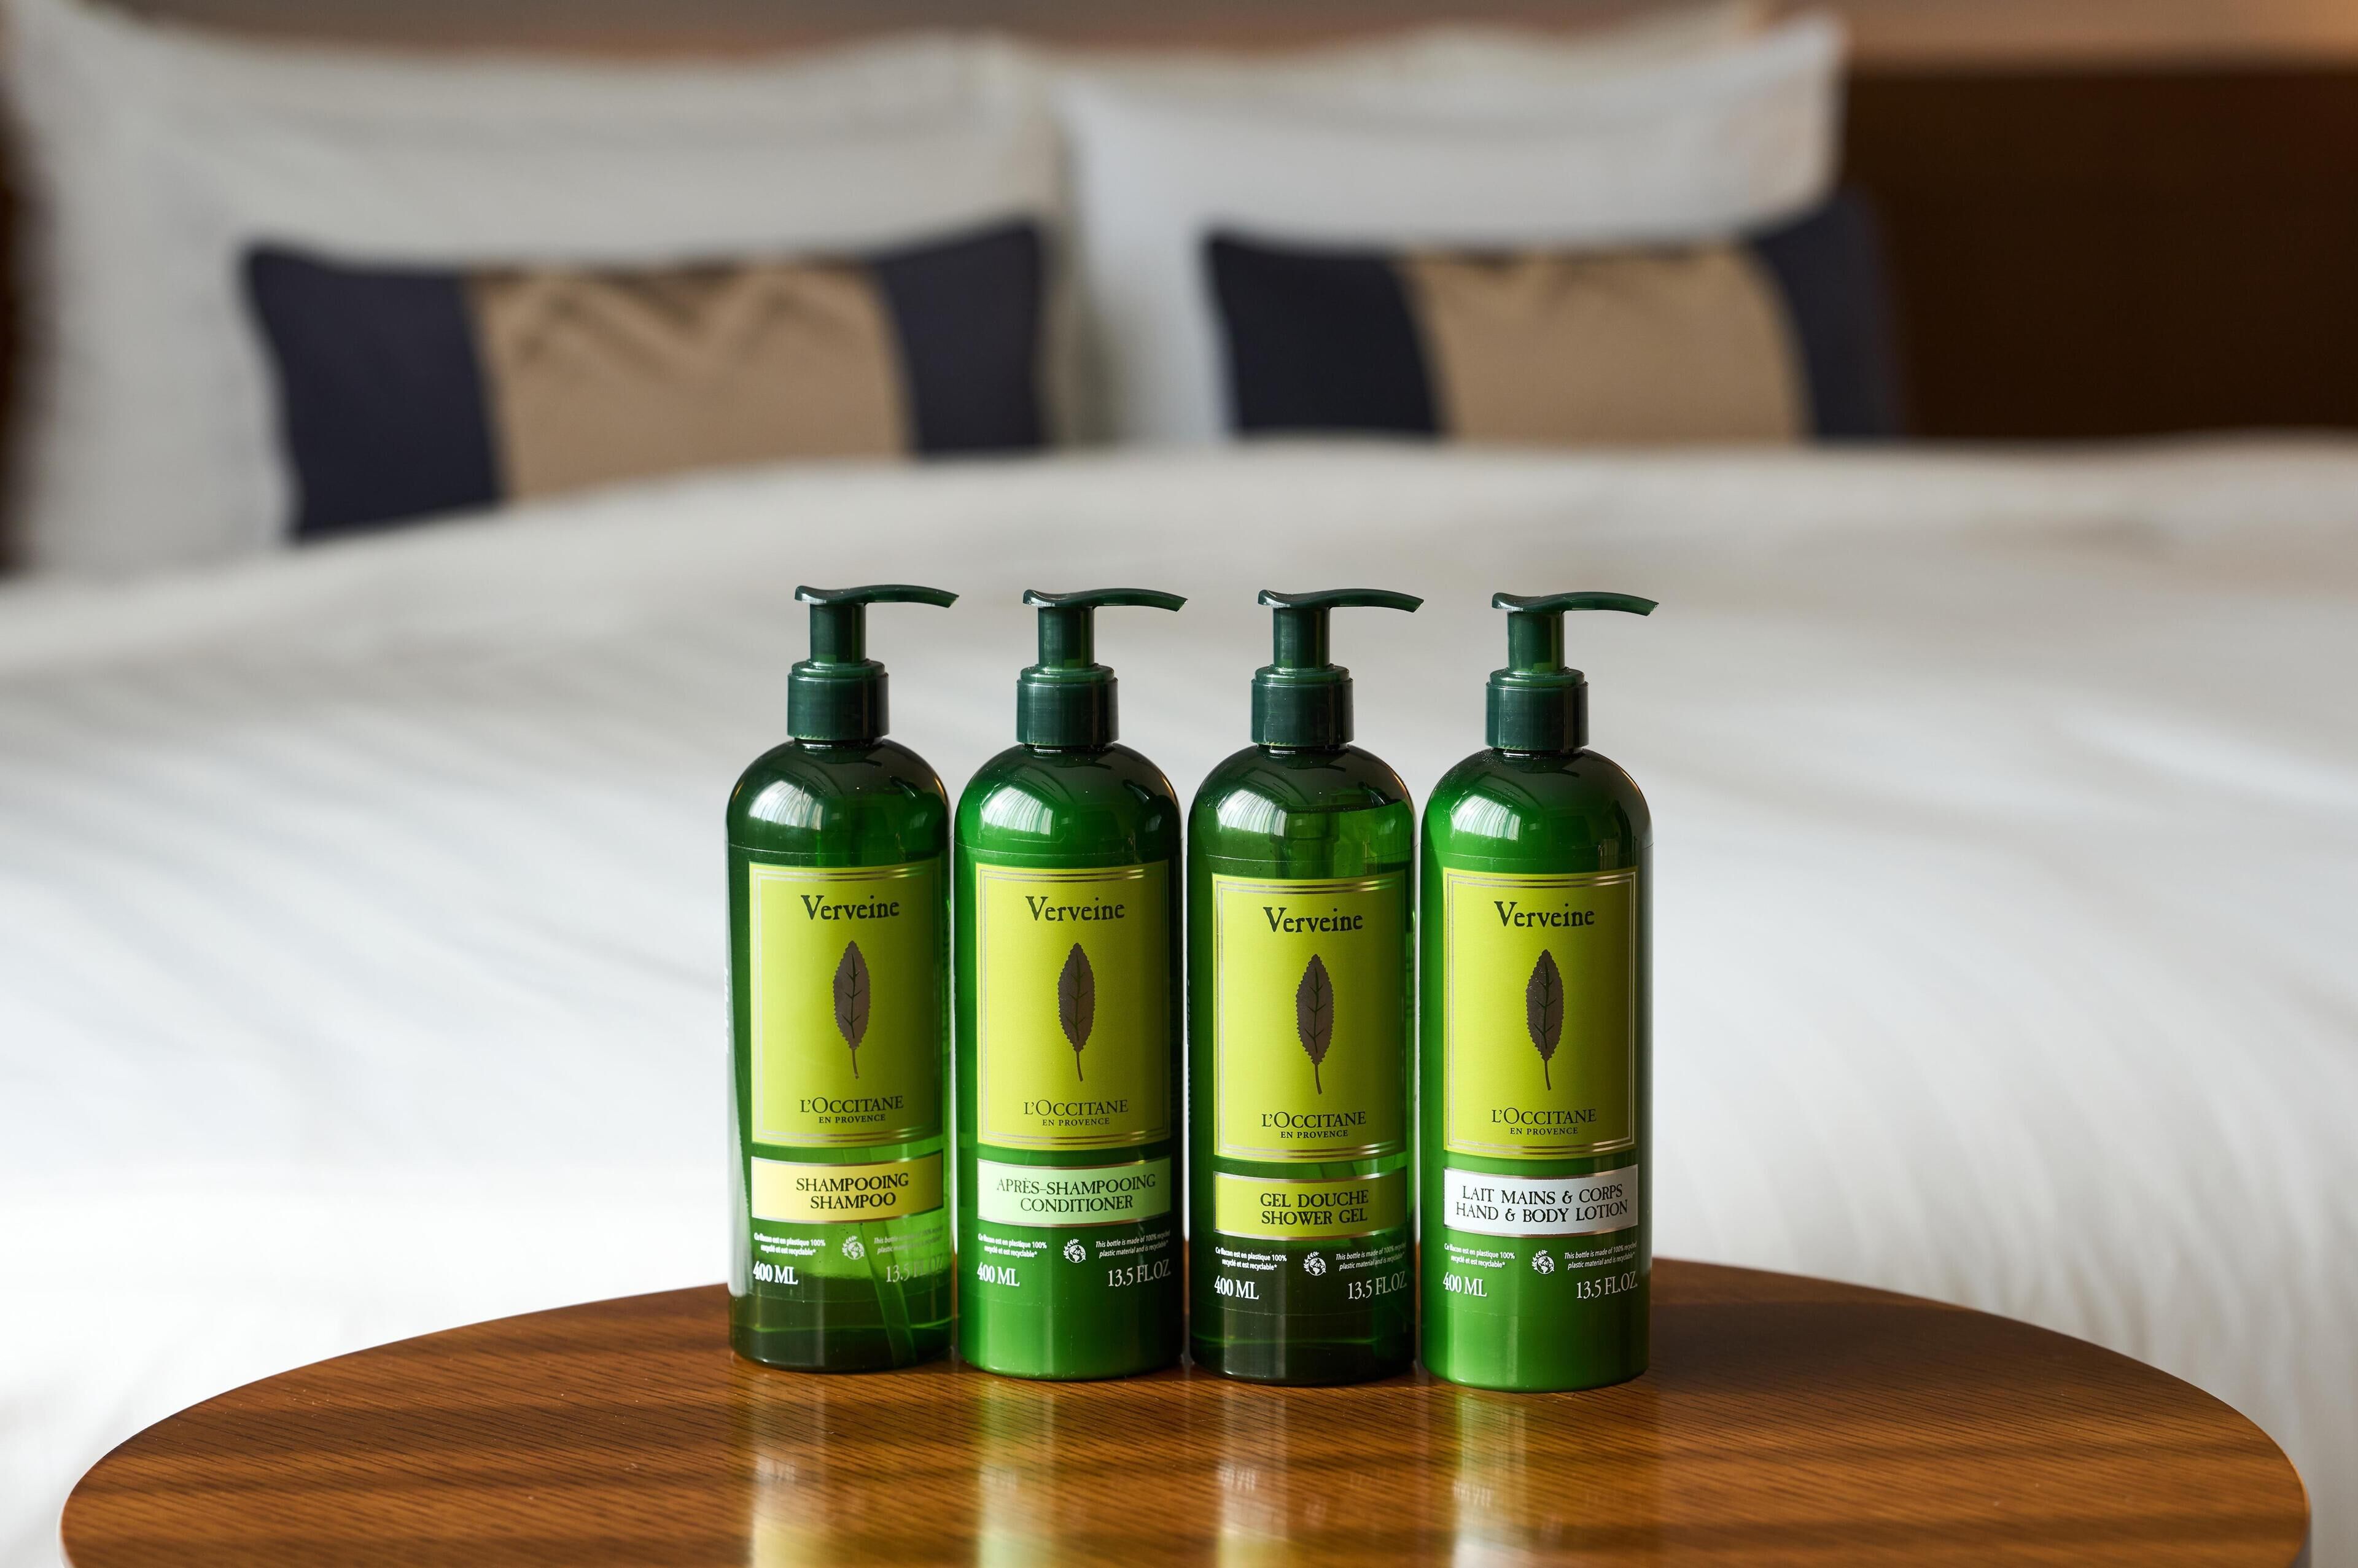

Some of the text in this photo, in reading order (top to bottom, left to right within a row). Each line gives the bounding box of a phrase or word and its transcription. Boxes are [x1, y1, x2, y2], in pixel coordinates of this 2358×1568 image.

[801, 895, 900, 920] Verveine
[1025, 896, 1125, 921] Verveine
[1493, 901, 1595, 927] Verveine
[1263, 906, 1363, 933] Verveine
[835, 1114, 885, 1123] PROVENCE
[1059, 1117, 1110, 1126] PROVENCE
[1297, 1130, 1348, 1138] PROVENCE
[796, 1173, 909, 1192] SHAMPOOING
[811, 1192, 896, 1209] SHAMPOO
[1260, 1190, 1369, 1208] GEL DOUCHE
[1463, 1184, 1622, 1205] LAIT MAINS & CORPS
[1021, 1195, 1133, 1213] CONDITIONER
[1456, 1199, 1627, 1223] HAND & BODY LOTION
[1261, 1208, 1368, 1225] SHOWER GEL
[786, 1238, 809, 1248] plastique
[877, 1246, 893, 1255] plastic
[1008, 1239, 1030, 1249] plastique
[1099, 1250, 1115, 1259] plastic
[1116, 1246, 1136, 1256] material
[1248, 1252, 1270, 1262] plastique
[1476, 1249, 1498, 1259] plastique
[753, 1260, 798, 1284] 400 ML
[887, 1262, 909, 1283] 13.5
[1339, 1262, 1355, 1271] plastic
[1356, 1259, 1374, 1268] material
[1568, 1261, 1584, 1270] plastic
[1585, 1259, 1603, 1267] material
[977, 1262, 1020, 1287] 400 ML
[1108, 1267, 1134, 1287] 13.5
[1215, 1275, 1259, 1299] 400 ML
[1348, 1279, 1372, 1299] 13.5
[1443, 1272, 1487, 1297] 400 ML
[1577, 1279, 1601, 1299] 13.5
